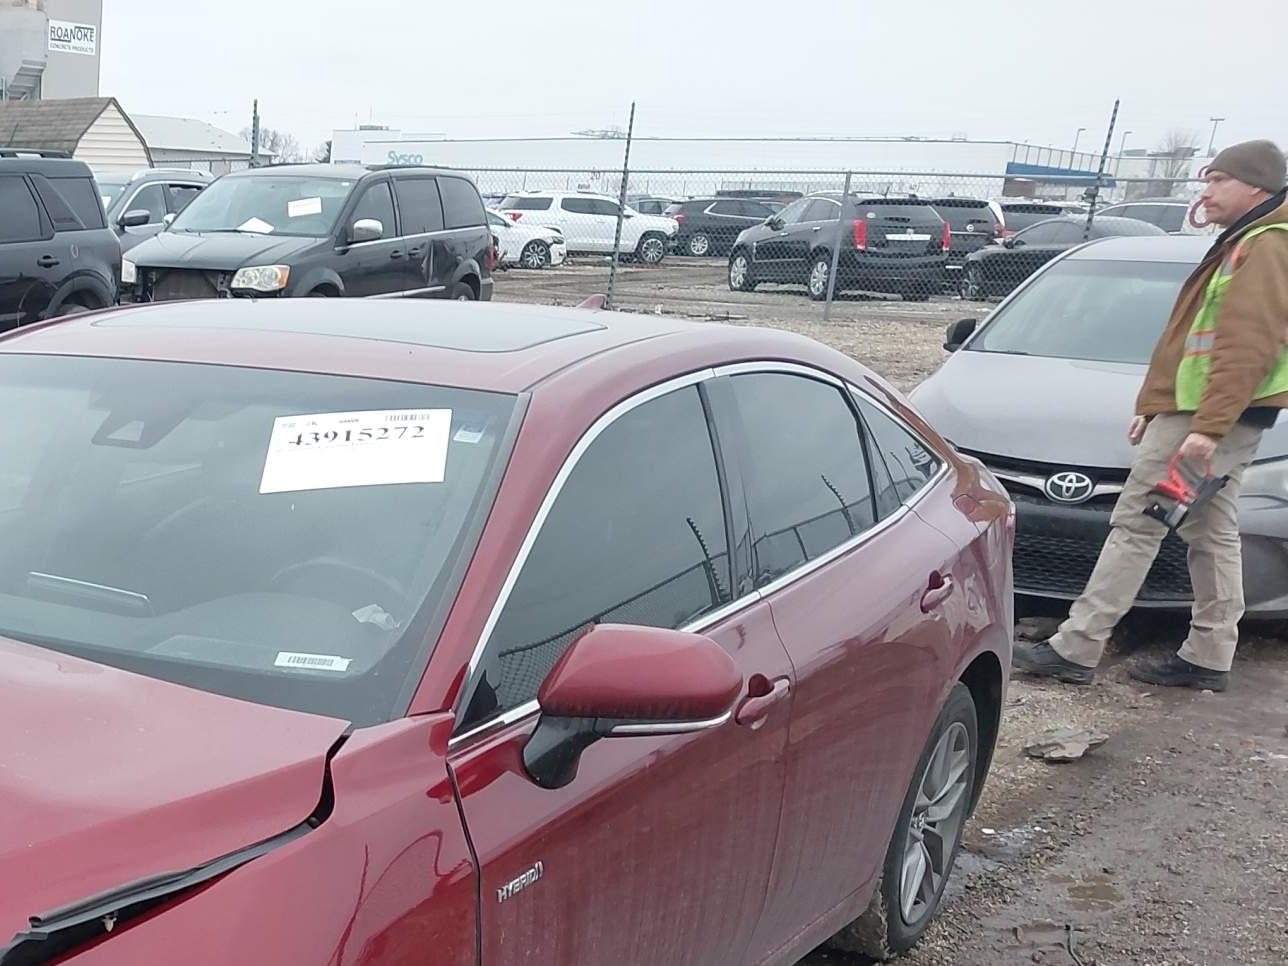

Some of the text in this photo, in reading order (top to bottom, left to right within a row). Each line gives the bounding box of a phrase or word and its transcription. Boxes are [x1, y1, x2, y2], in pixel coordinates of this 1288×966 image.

[50, 26, 94, 43] ROANOKE
[388, 150, 423, 165] Sysco
[288, 425, 425, 446] 43915272
[497, 865, 541, 903] HYBRID
